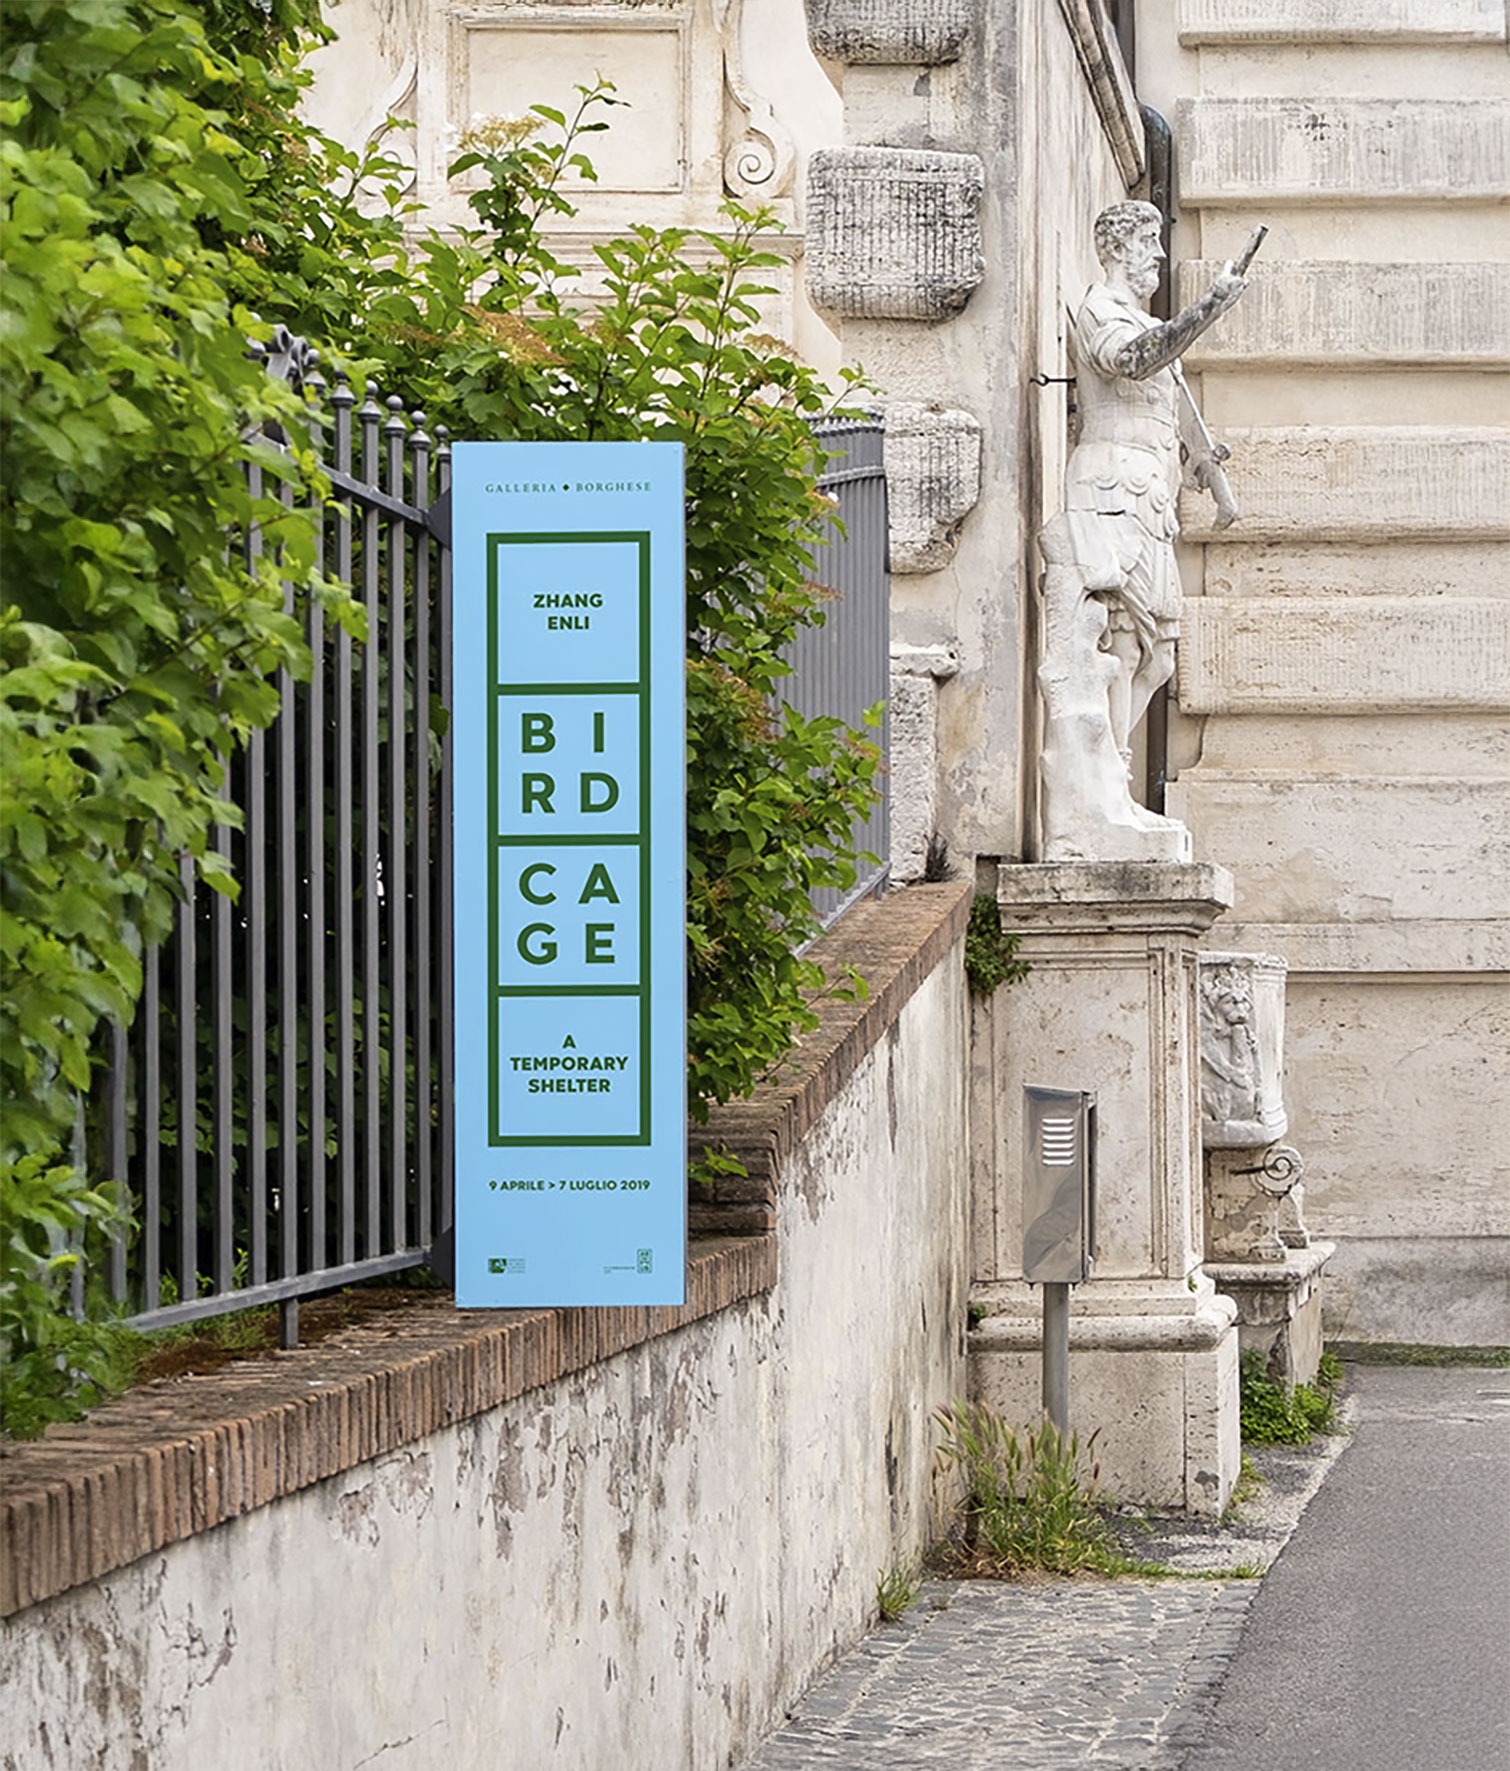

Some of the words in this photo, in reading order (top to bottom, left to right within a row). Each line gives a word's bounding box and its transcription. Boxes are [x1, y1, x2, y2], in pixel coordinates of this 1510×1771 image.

[485, 483, 557, 493] GALLERIA
[576, 482, 651, 492] BORGHESE
[533, 593, 603, 608] ZHANG
[547, 616, 590, 630] ENLI
[563, 1035, 576, 1049] A
[510, 1056, 628, 1071] TEMPORARY
[528, 1078, 611, 1093] SHELTER
[489, 1181, 497, 1191] 9
[500, 1181, 545, 1191] APRILE
[559, 1181, 566, 1190] 7
[570, 1180, 617, 1190] LUGLIO
[620, 1180, 651, 1190] 2019
